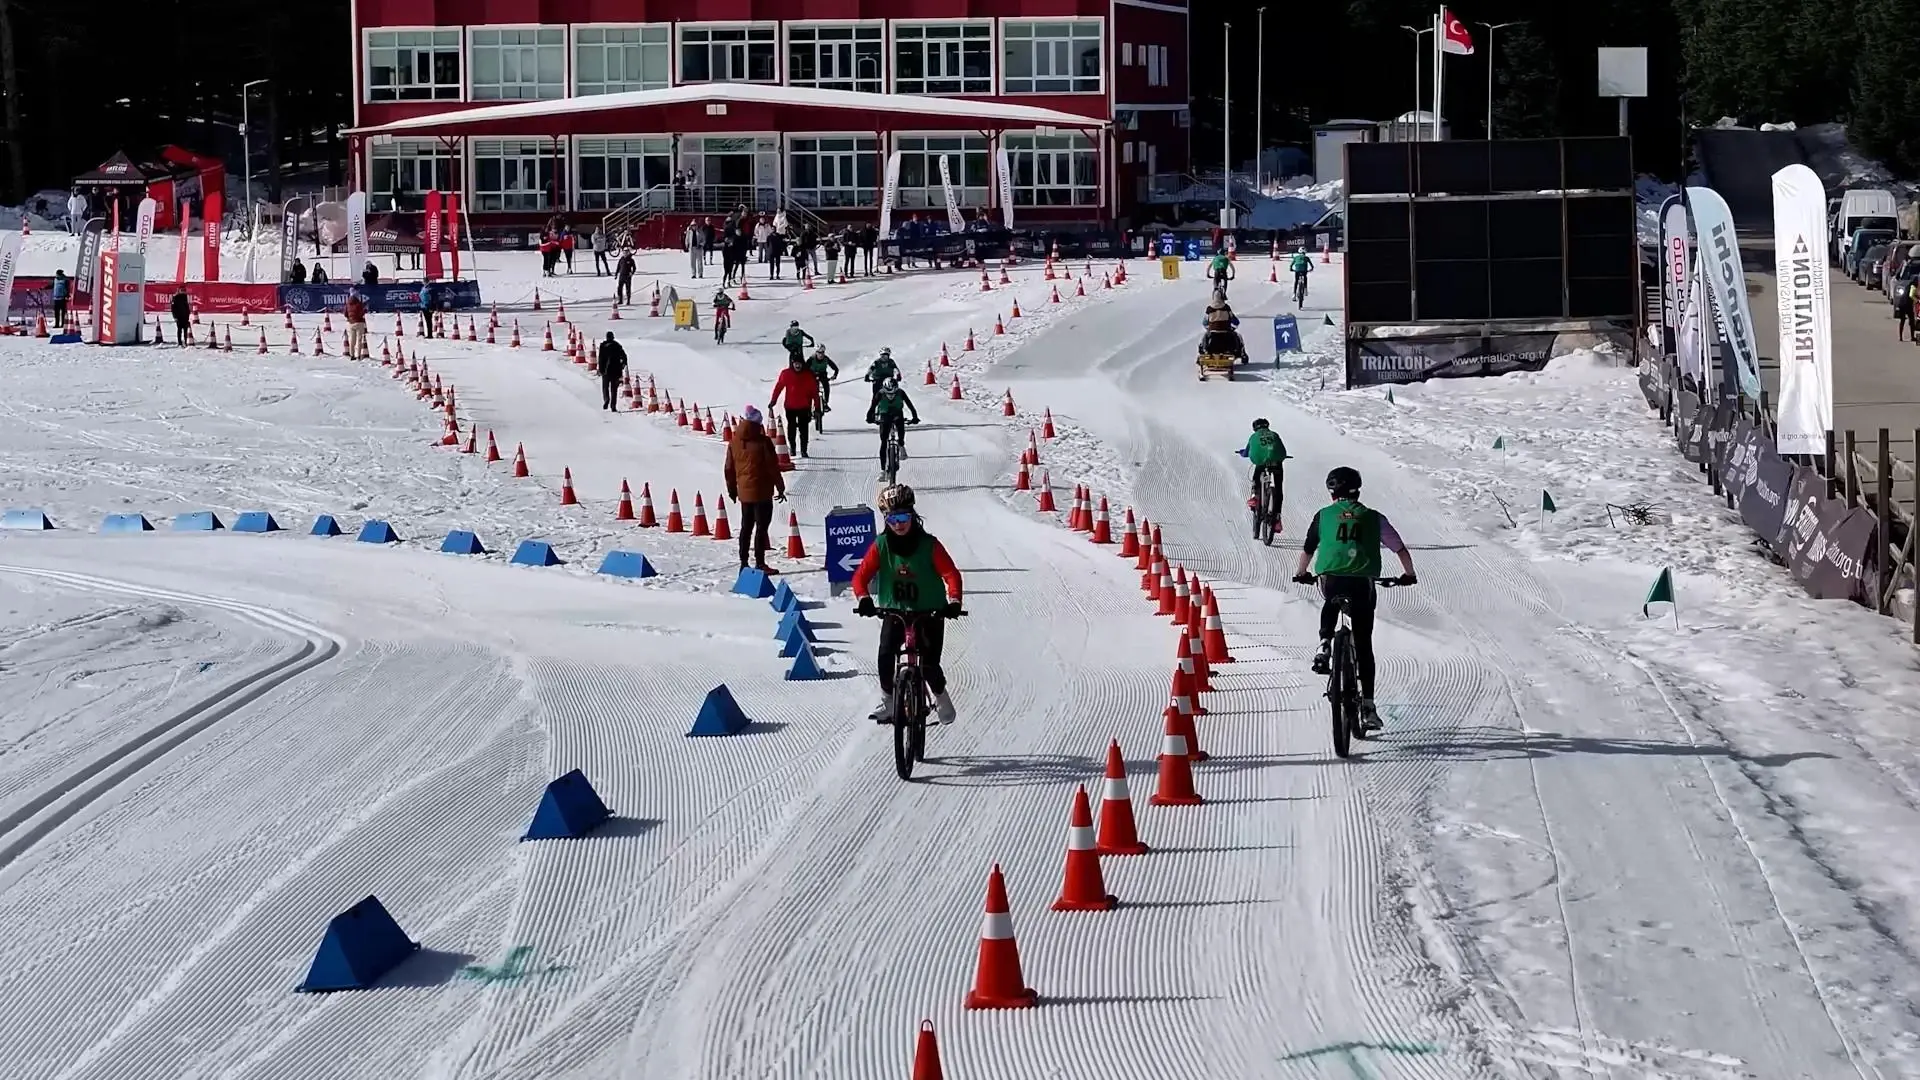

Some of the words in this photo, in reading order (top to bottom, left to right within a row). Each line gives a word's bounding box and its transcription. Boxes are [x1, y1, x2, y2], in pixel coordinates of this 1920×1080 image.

[77, 230, 95, 292] Bianchi
[102, 256, 114, 337] FINISH
[829, 524, 871, 536] KAYAKLI
[1336, 522, 1362, 544] 44
[837, 535, 864, 547] KOŞU
[893, 580, 919, 601] 60
